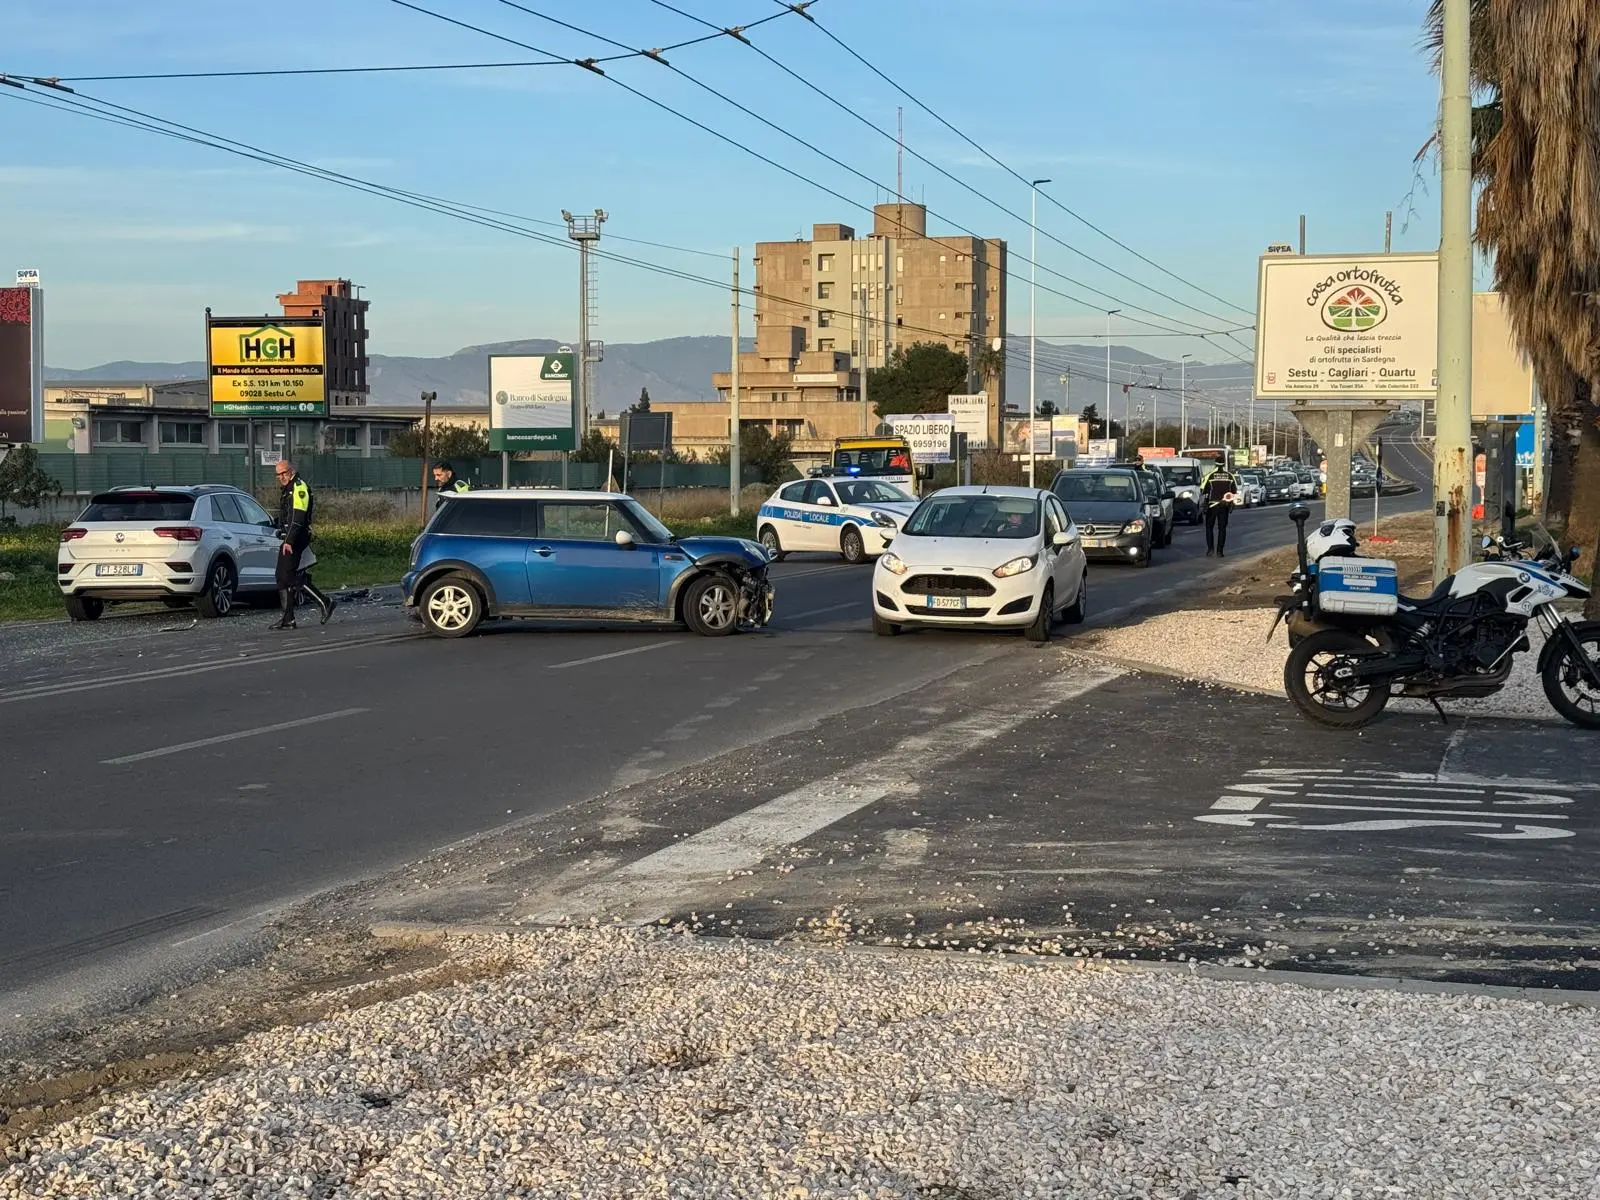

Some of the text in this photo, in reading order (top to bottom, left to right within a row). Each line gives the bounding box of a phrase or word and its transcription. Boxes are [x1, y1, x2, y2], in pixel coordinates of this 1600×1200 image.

[1336, 266, 1404, 306] ortofrutta
[244, 337, 296, 359] HGH
[1337, 346, 1382, 355] specialisti
[1288, 368, 1317, 377] Sestu
[1328, 367, 1368, 379] Cagliari
[1379, 368, 1416, 377] Quartu
[537, 393, 568, 402] Sardegna
[895, 424, 949, 435] SPAZIO LIBERO
[783, 510, 830, 523] POLIZIA LOCALE
